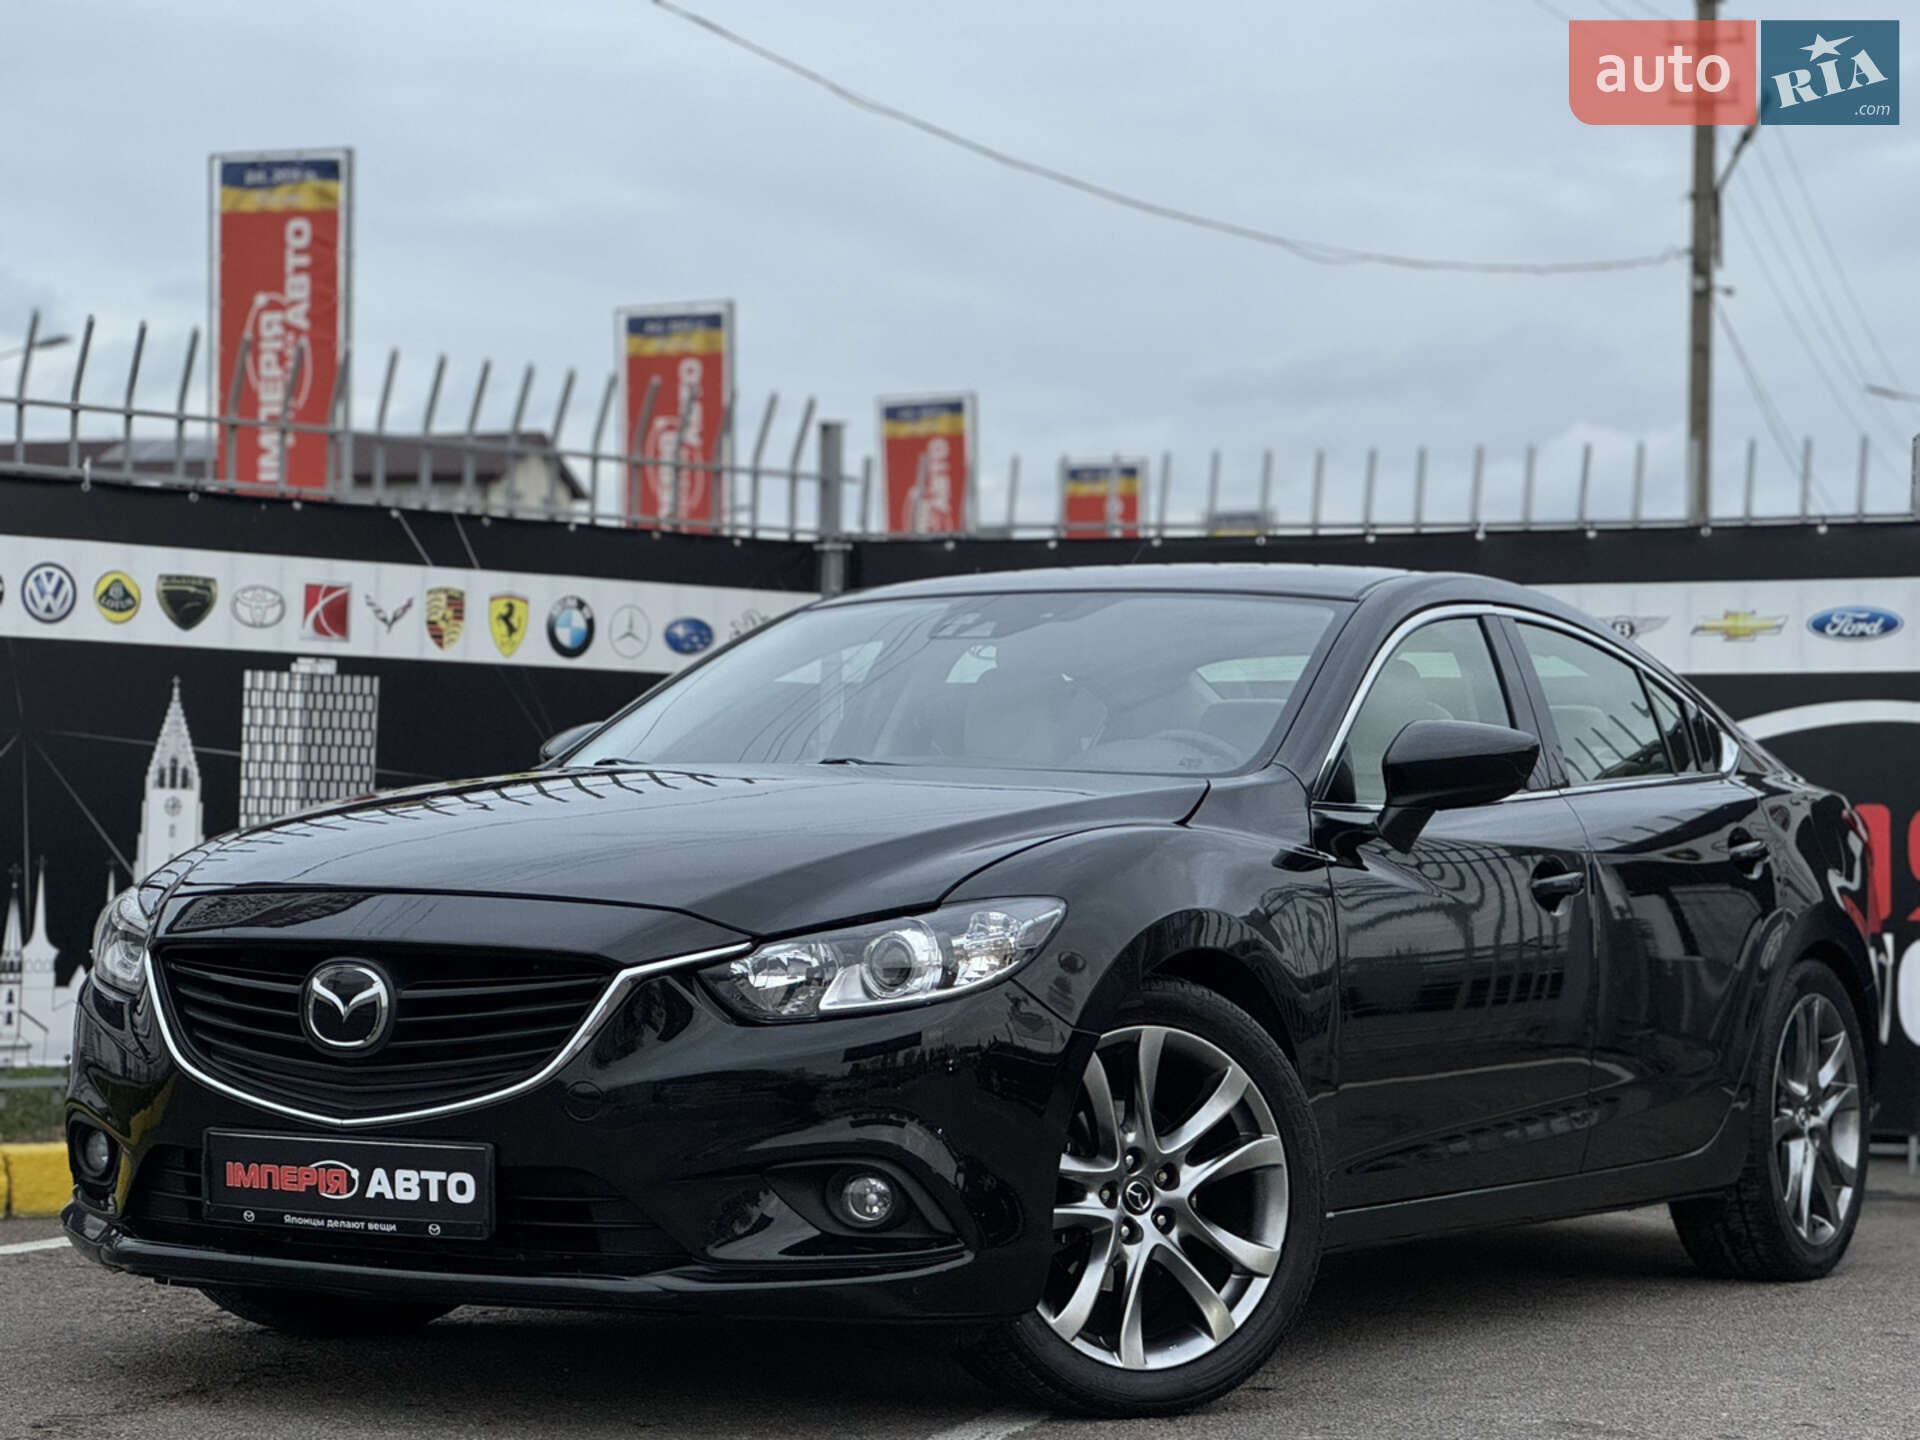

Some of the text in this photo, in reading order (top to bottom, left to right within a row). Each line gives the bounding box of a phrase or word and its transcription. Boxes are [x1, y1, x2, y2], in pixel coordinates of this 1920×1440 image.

[285, 217, 311, 331] АВТО
[1824, 612, 1884, 637] Ford
[226, 1161, 477, 1204] ІМПЕРІЯ АВТО
[283, 1214, 397, 1232] Японцы делают вещи
